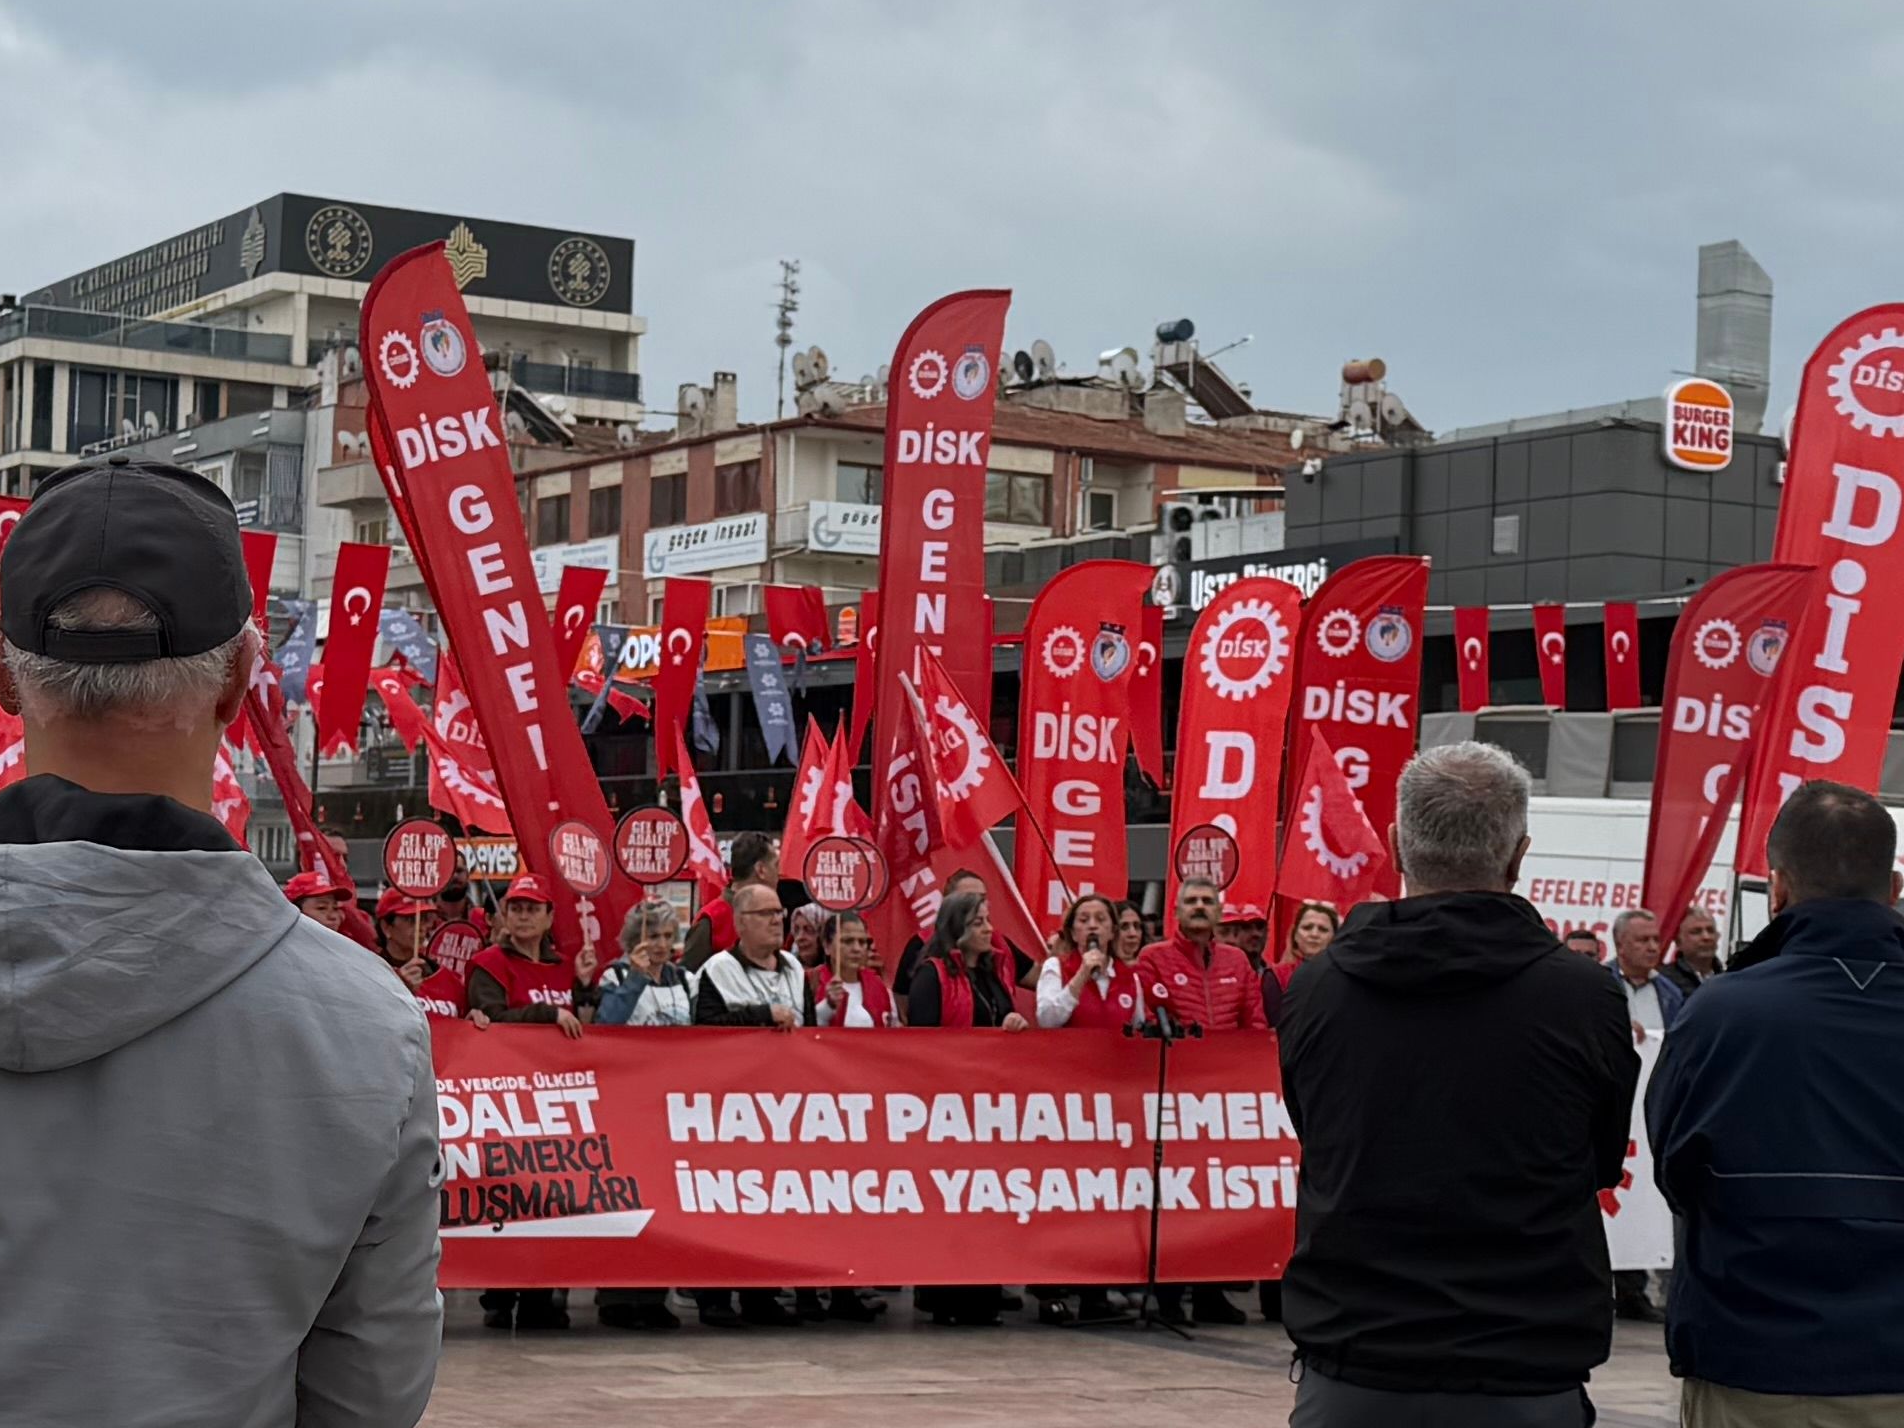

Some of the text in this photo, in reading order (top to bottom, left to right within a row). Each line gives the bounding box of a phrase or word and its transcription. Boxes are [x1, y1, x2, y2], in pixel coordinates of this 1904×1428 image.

[396, 407, 500, 469] DİSK
[1672, 424, 1730, 451] KING
[1673, 406, 1730, 427] BURGER
[897, 422, 985, 465] DİSK
[1219, 632, 1268, 659] DİSK
[1303, 679, 1411, 729] DİSK
[1672, 693, 1760, 741] DİS
[1033, 701, 1120, 764] DİSK
[1530, 878, 1607, 907] EFELER
[462, 1075, 533, 1093] VERGİDE,
[533, 1071, 596, 1089] ÜLKEDE
[438, 1087, 600, 1139] DALET
[666, 1092, 873, 1143] HAYAT
[885, 1092, 1133, 1148] PAHALI,
[440, 1175, 642, 1232] LUŞMALARI
[675, 1156, 1299, 1224] İNSANCA YAŞAMAK İSTİ
